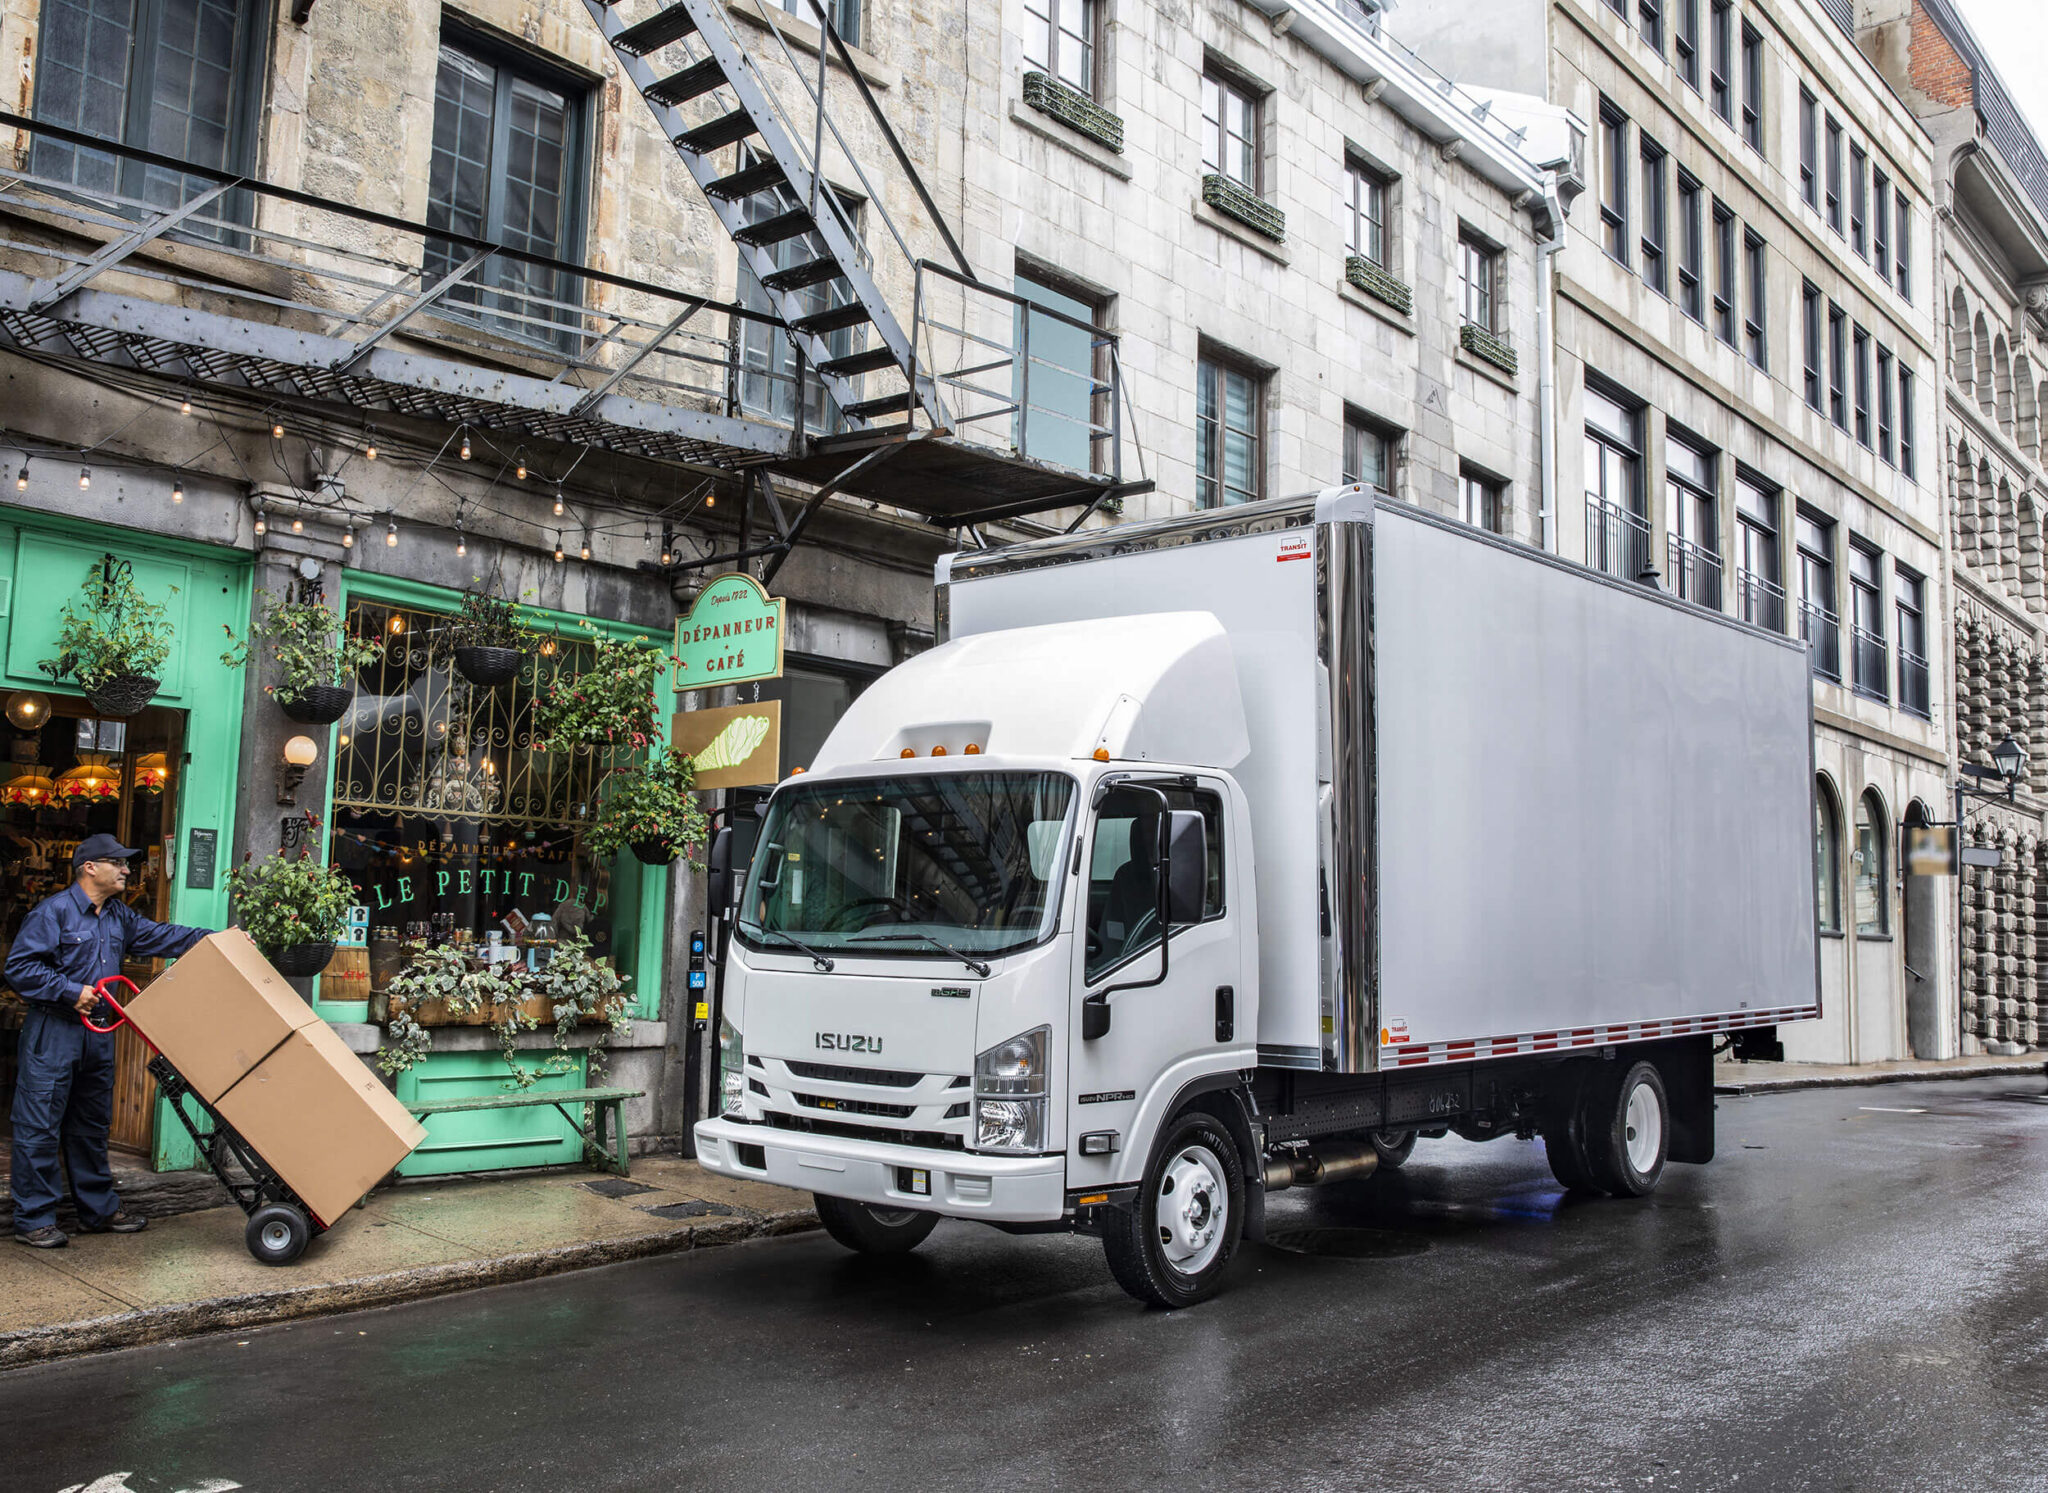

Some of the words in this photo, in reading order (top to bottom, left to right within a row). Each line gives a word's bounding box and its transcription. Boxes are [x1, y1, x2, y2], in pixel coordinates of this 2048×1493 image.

[1280, 543, 1307, 552] TRANSIT
[683, 616, 775, 645] DÉPANNEUR
[706, 649, 745, 672] CAFÉ
[417, 839, 511, 857] DÉPANNEUR
[373, 876, 415, 911] LE
[436, 869, 535, 897] PETIT
[552, 878, 607, 916] DEP
[343, 970, 366, 981] ATM
[815, 1031, 883, 1054] ISUZU
